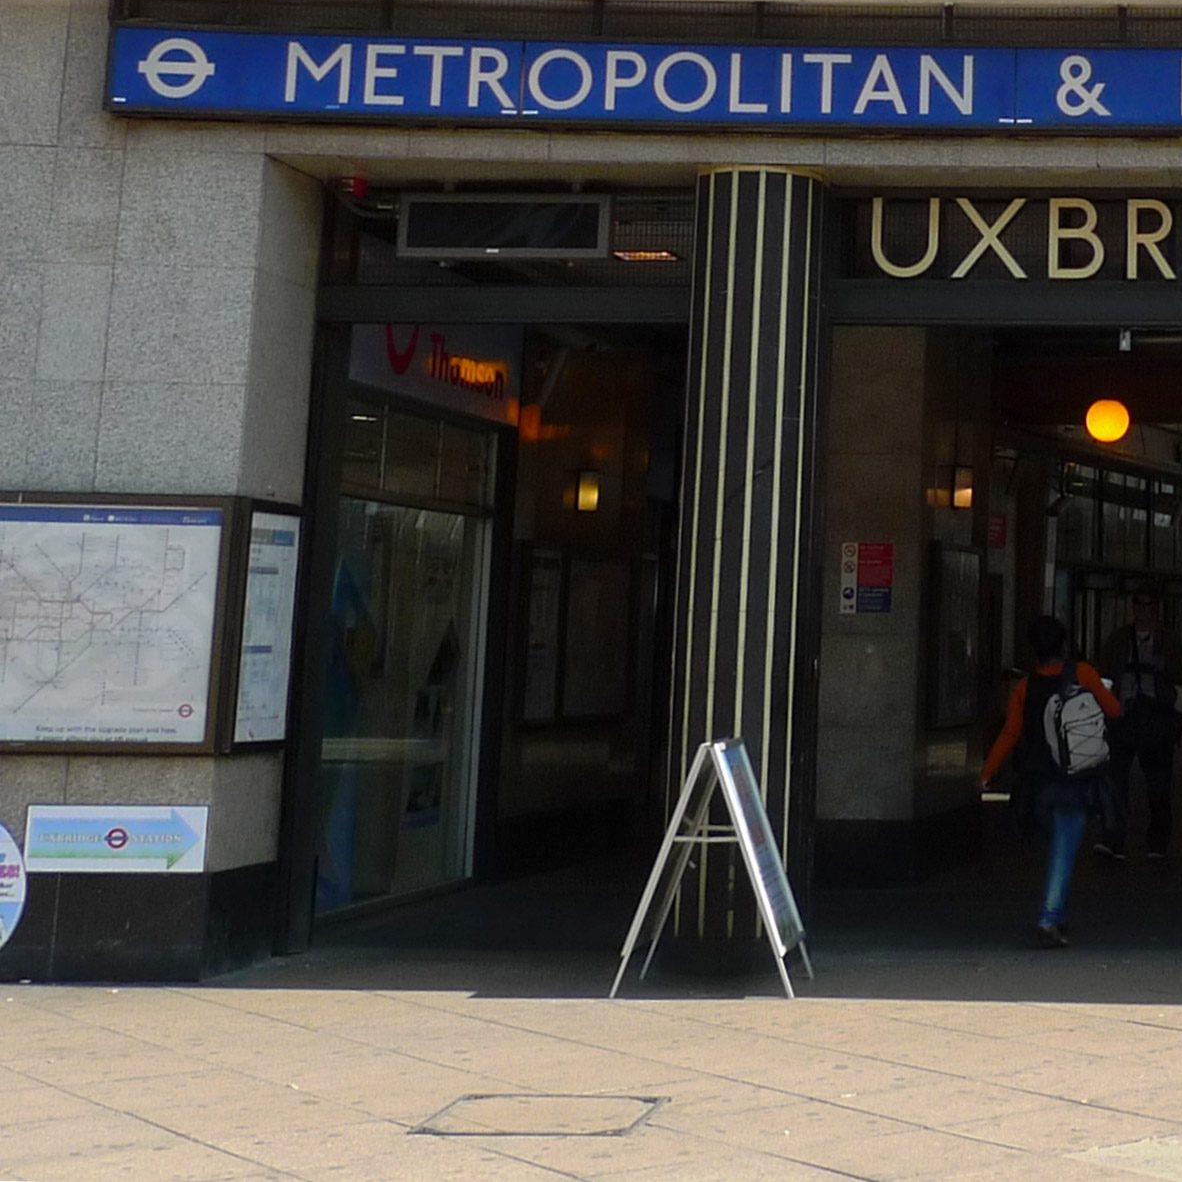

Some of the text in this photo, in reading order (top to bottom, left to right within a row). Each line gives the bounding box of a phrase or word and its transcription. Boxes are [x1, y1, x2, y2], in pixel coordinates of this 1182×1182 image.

[284, 41, 974, 116] METROPOLITAN
[1056, 55, 1111, 116] &
[430, 331, 504, 399] Thomson
[131, 833, 182, 844] STATION
